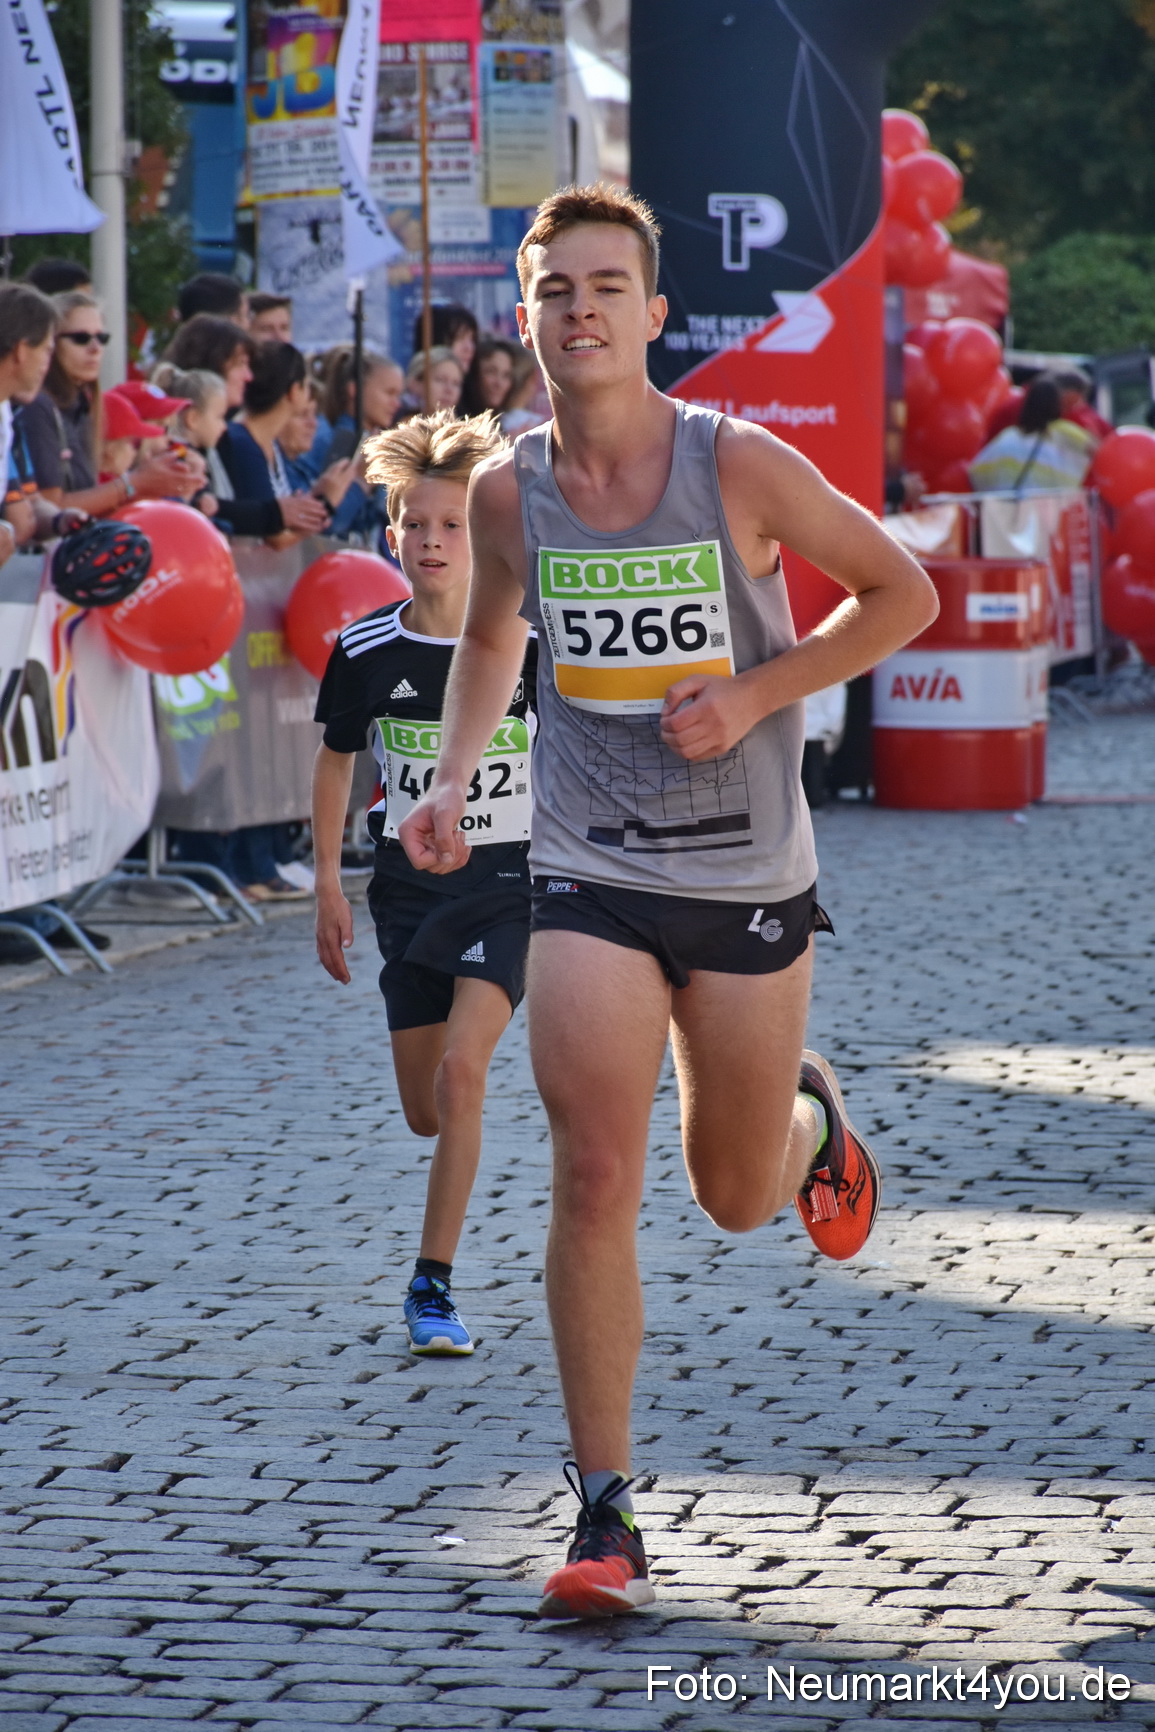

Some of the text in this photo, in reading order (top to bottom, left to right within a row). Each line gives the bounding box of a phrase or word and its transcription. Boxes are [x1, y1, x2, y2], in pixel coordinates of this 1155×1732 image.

[686, 315, 766, 334] THE NEXT
[665, 332, 747, 351] 100 YEARS
[725, 400, 837, 428] Laufsport
[550, 552, 704, 592] BOCK
[562, 604, 708, 657] 5266
[390, 690, 418, 699] adidas
[392, 723, 515, 754] BOK
[457, 813, 492, 831] ON
